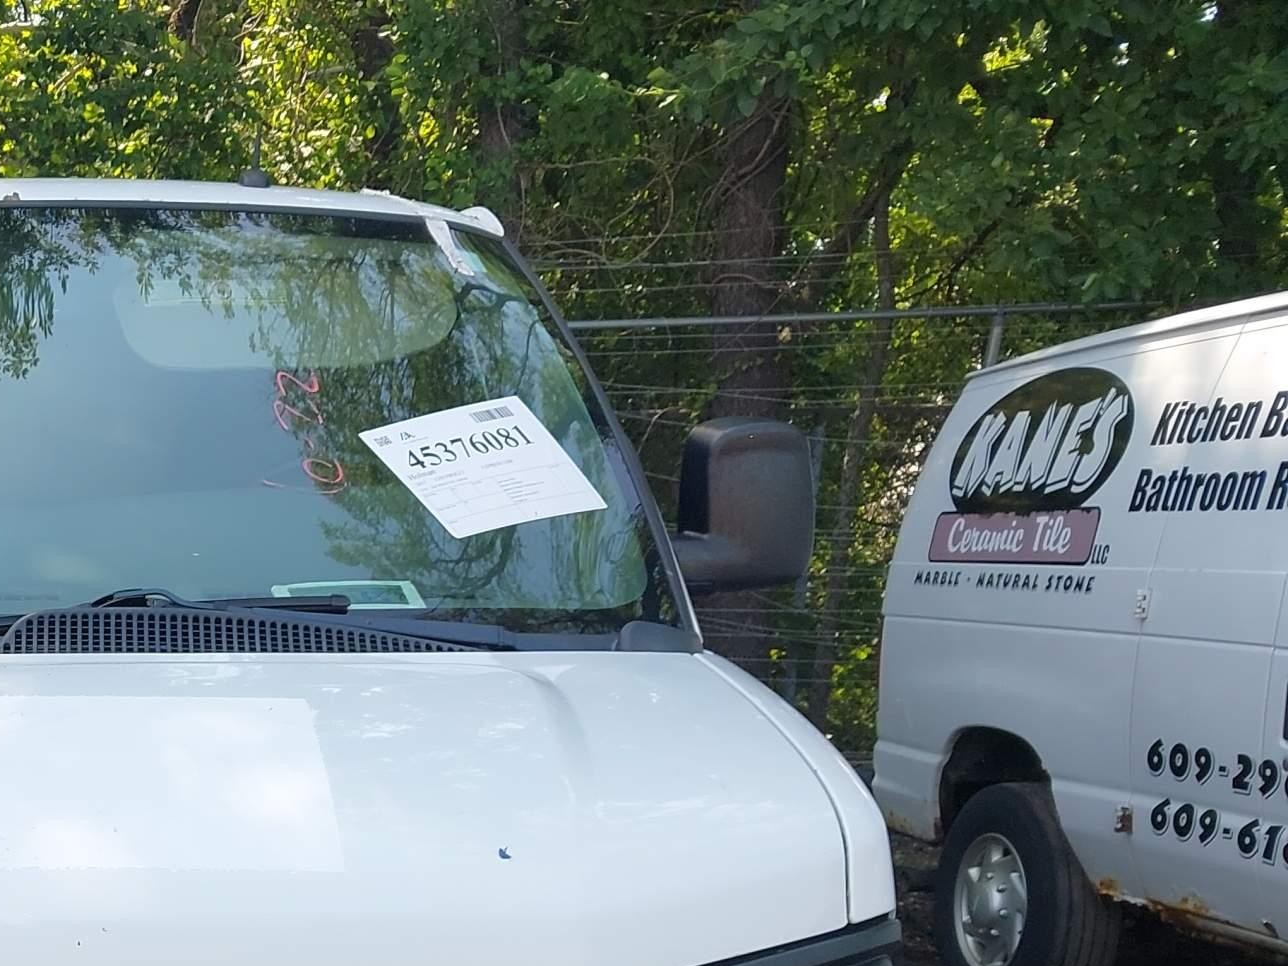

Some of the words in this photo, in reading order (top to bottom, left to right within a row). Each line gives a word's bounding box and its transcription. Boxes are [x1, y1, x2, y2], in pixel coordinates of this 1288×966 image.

[1150, 397, 1263, 446] Kitchen
[408, 425, 535, 469] 45376081
[1128, 466, 1267, 512] Bathroom
[948, 518, 1025, 553] Ceramic
[1032, 515, 1071, 554] Tile
[1090, 544, 1110, 565] LLC
[914, 571, 961, 586] MARBLE
[976, 573, 1039, 593] NATURAL
[1045, 575, 1096, 593] STONE
[1147, 738, 1288, 801] 609-29
